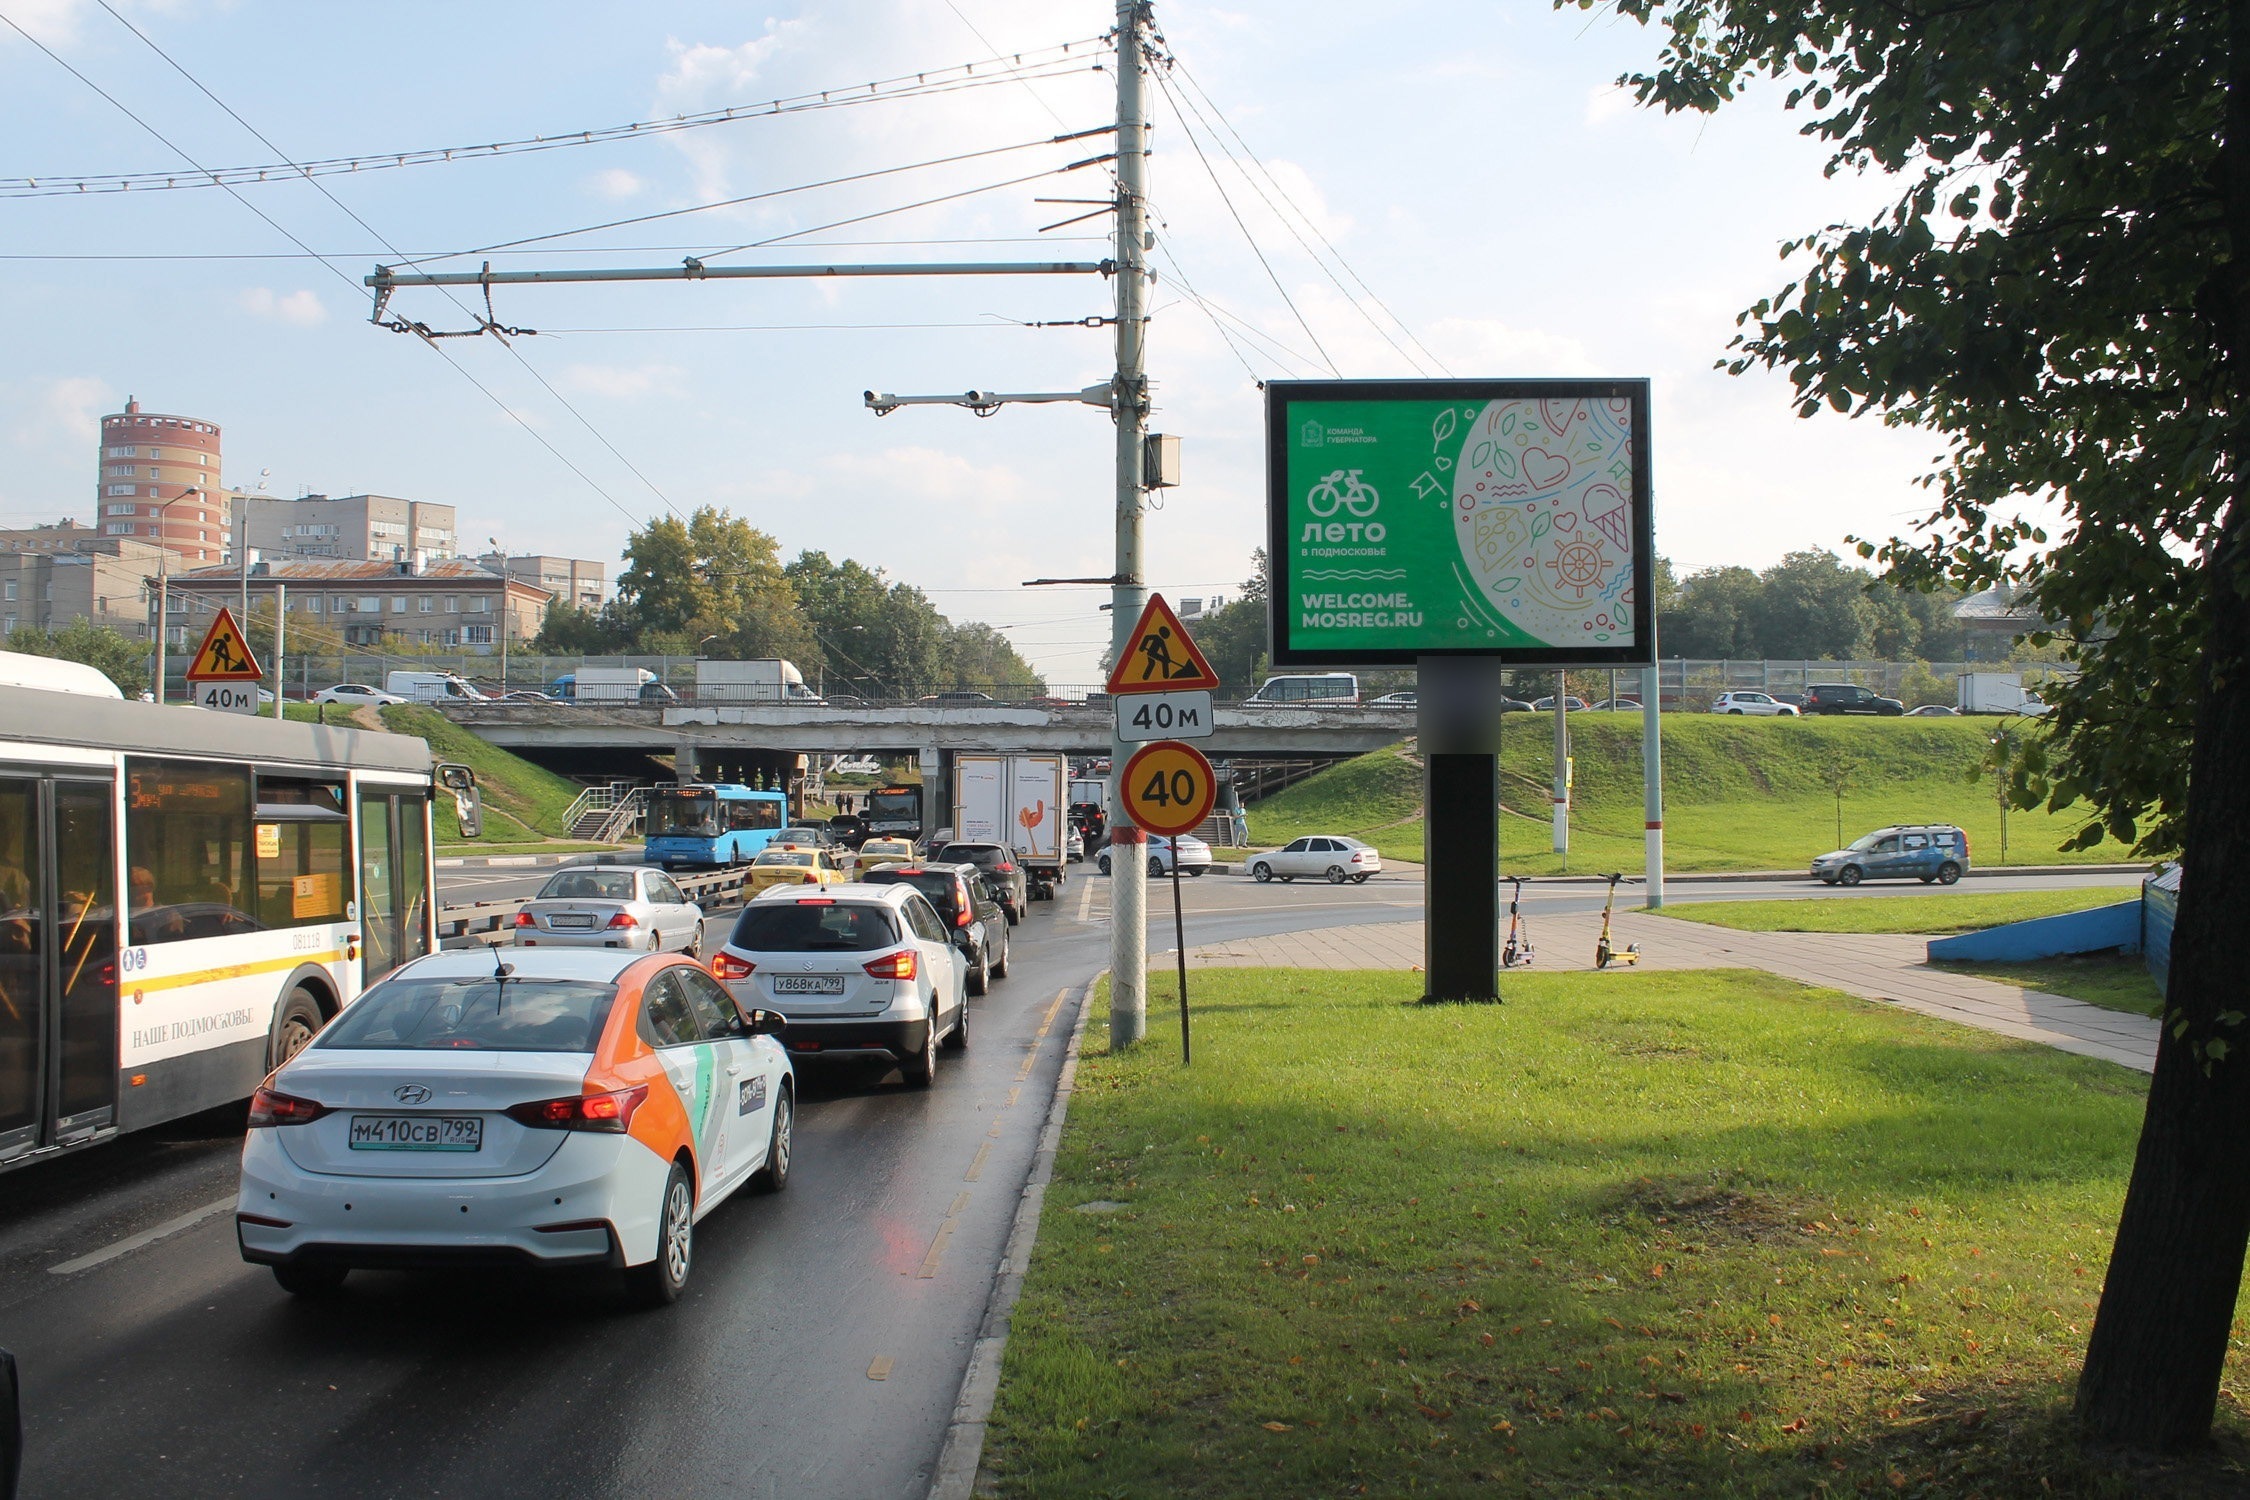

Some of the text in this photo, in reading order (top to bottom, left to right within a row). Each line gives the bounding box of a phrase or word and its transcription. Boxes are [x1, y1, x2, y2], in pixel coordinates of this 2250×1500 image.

[1326, 428, 1364, 436] КОМАНДА
[1326, 436, 1377, 444] ГУБЕРНАТОРА
[1311, 547, 1387, 558] ПОДМОСКОВЬЕ
[1301, 593, 1414, 609] WELCOME.
[1302, 611, 1423, 629] MOSREG.RU
[1142, 769, 1195, 807] 40
[292, 932, 321, 950] 081118
[823, 978, 840, 988] 799
[132, 1025, 169, 1049] НАШЕ
[443, 1119, 476, 1137] 799
